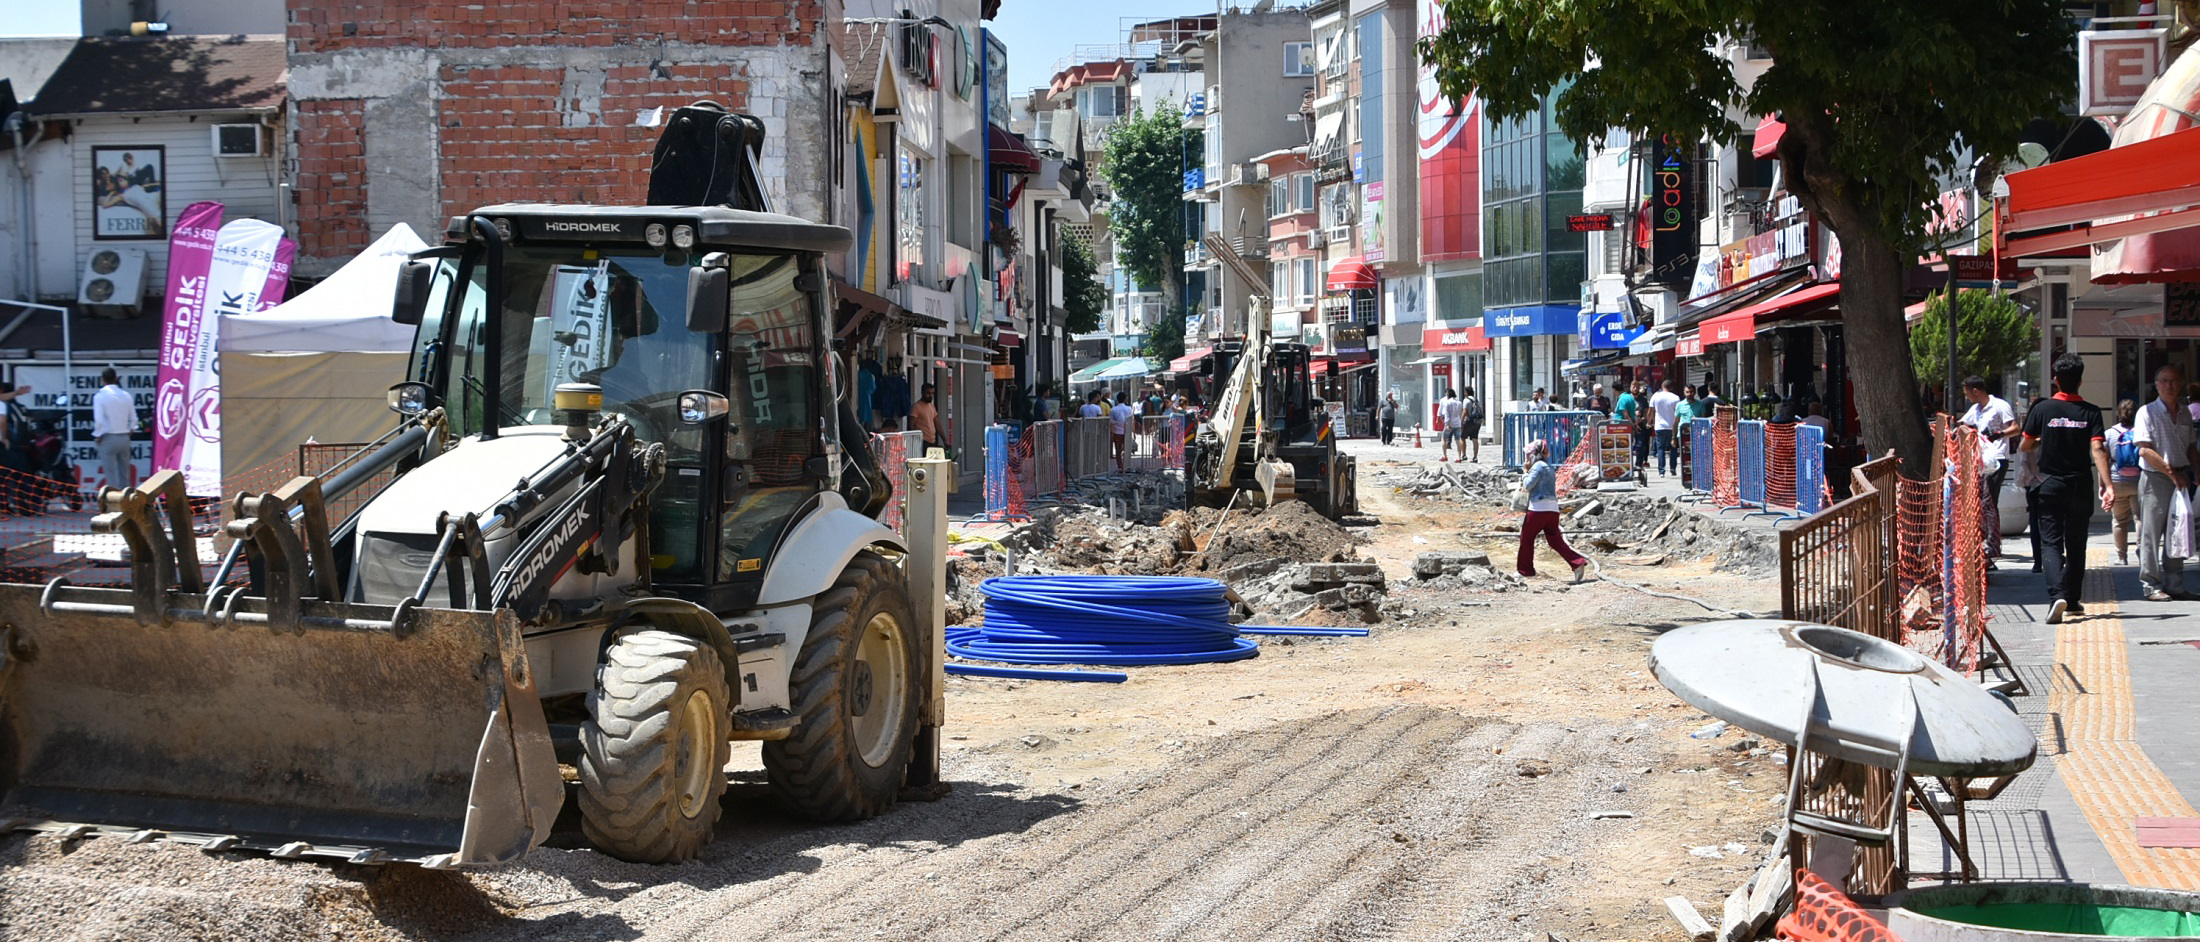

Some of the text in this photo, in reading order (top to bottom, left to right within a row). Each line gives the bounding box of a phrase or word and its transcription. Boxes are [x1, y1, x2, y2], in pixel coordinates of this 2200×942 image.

[2104, 48, 2146, 97] E
[240, 247, 248, 257] 5
[250, 250, 272, 263] 438
[1657, 253, 1689, 277] PS3
[1608, 322, 1623, 331] ERDE
[1442, 332, 1469, 345] AKBANK
[194, 331, 210, 372] İstanbul
